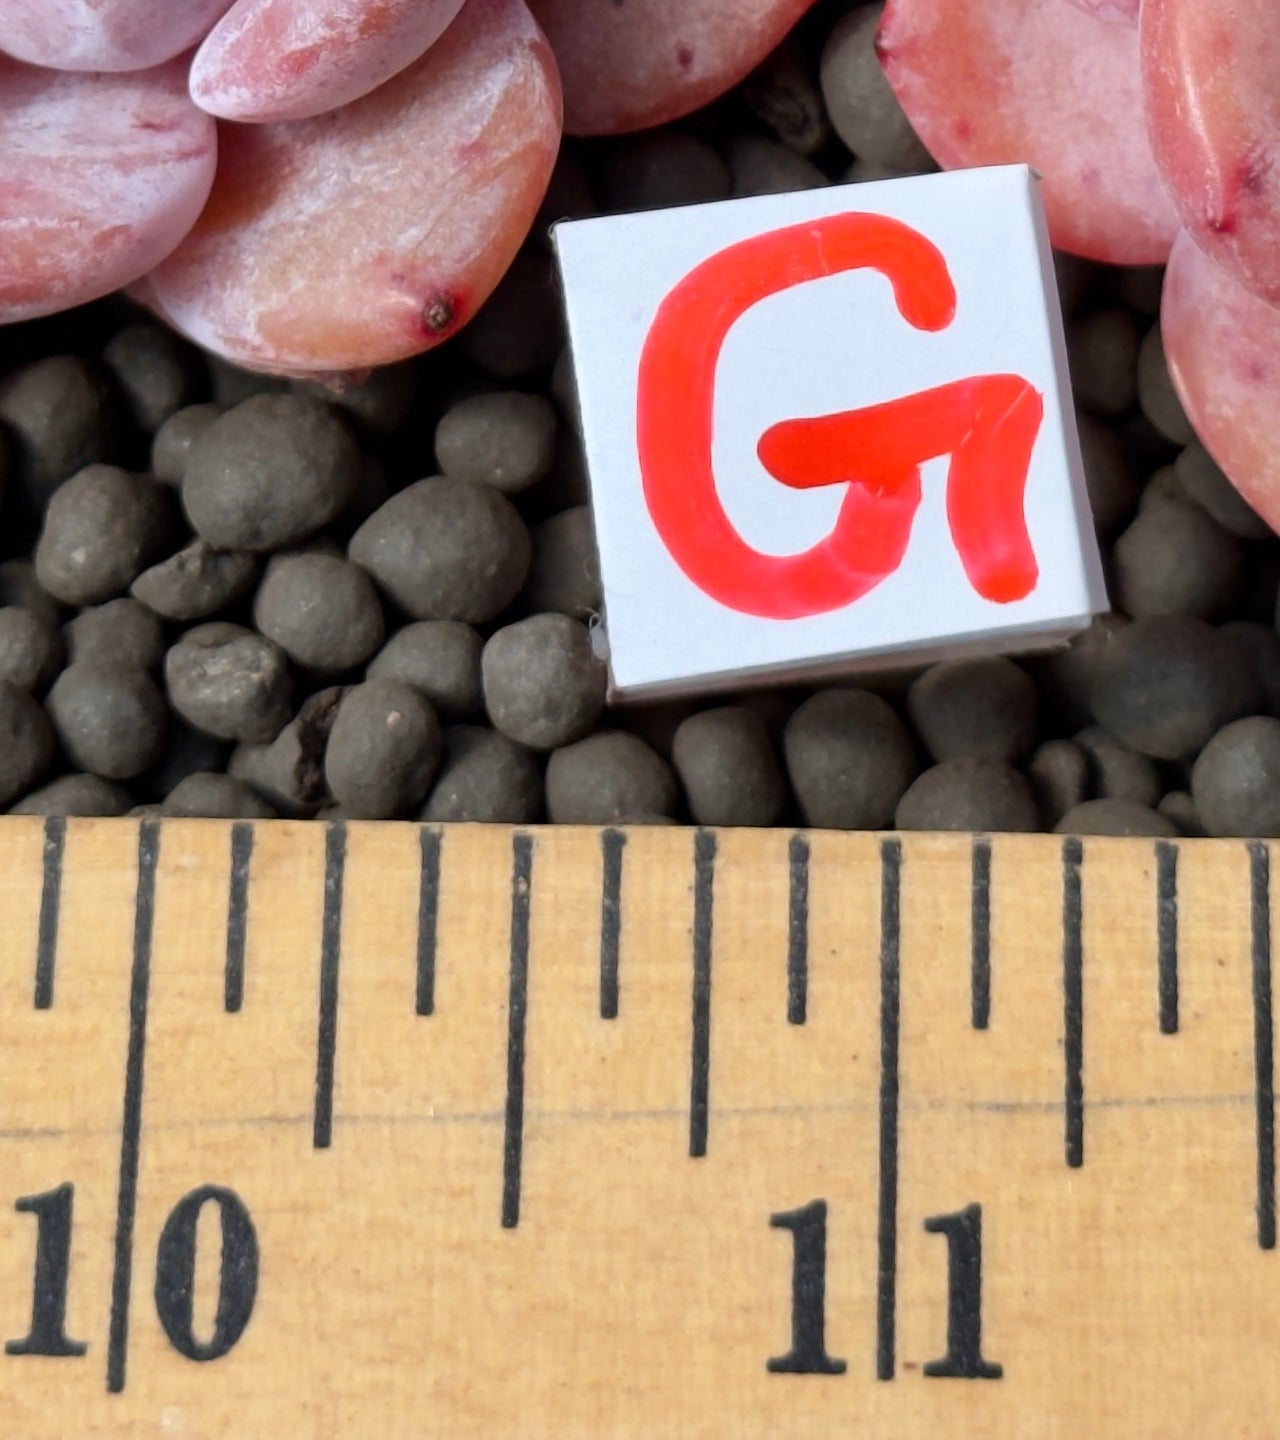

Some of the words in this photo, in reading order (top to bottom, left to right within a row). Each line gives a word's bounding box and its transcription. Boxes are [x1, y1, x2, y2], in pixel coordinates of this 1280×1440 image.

[633, 210, 1046, 622] G
[3, 1182, 261, 1363] 10
[765, 1198, 1005, 1381] 11
